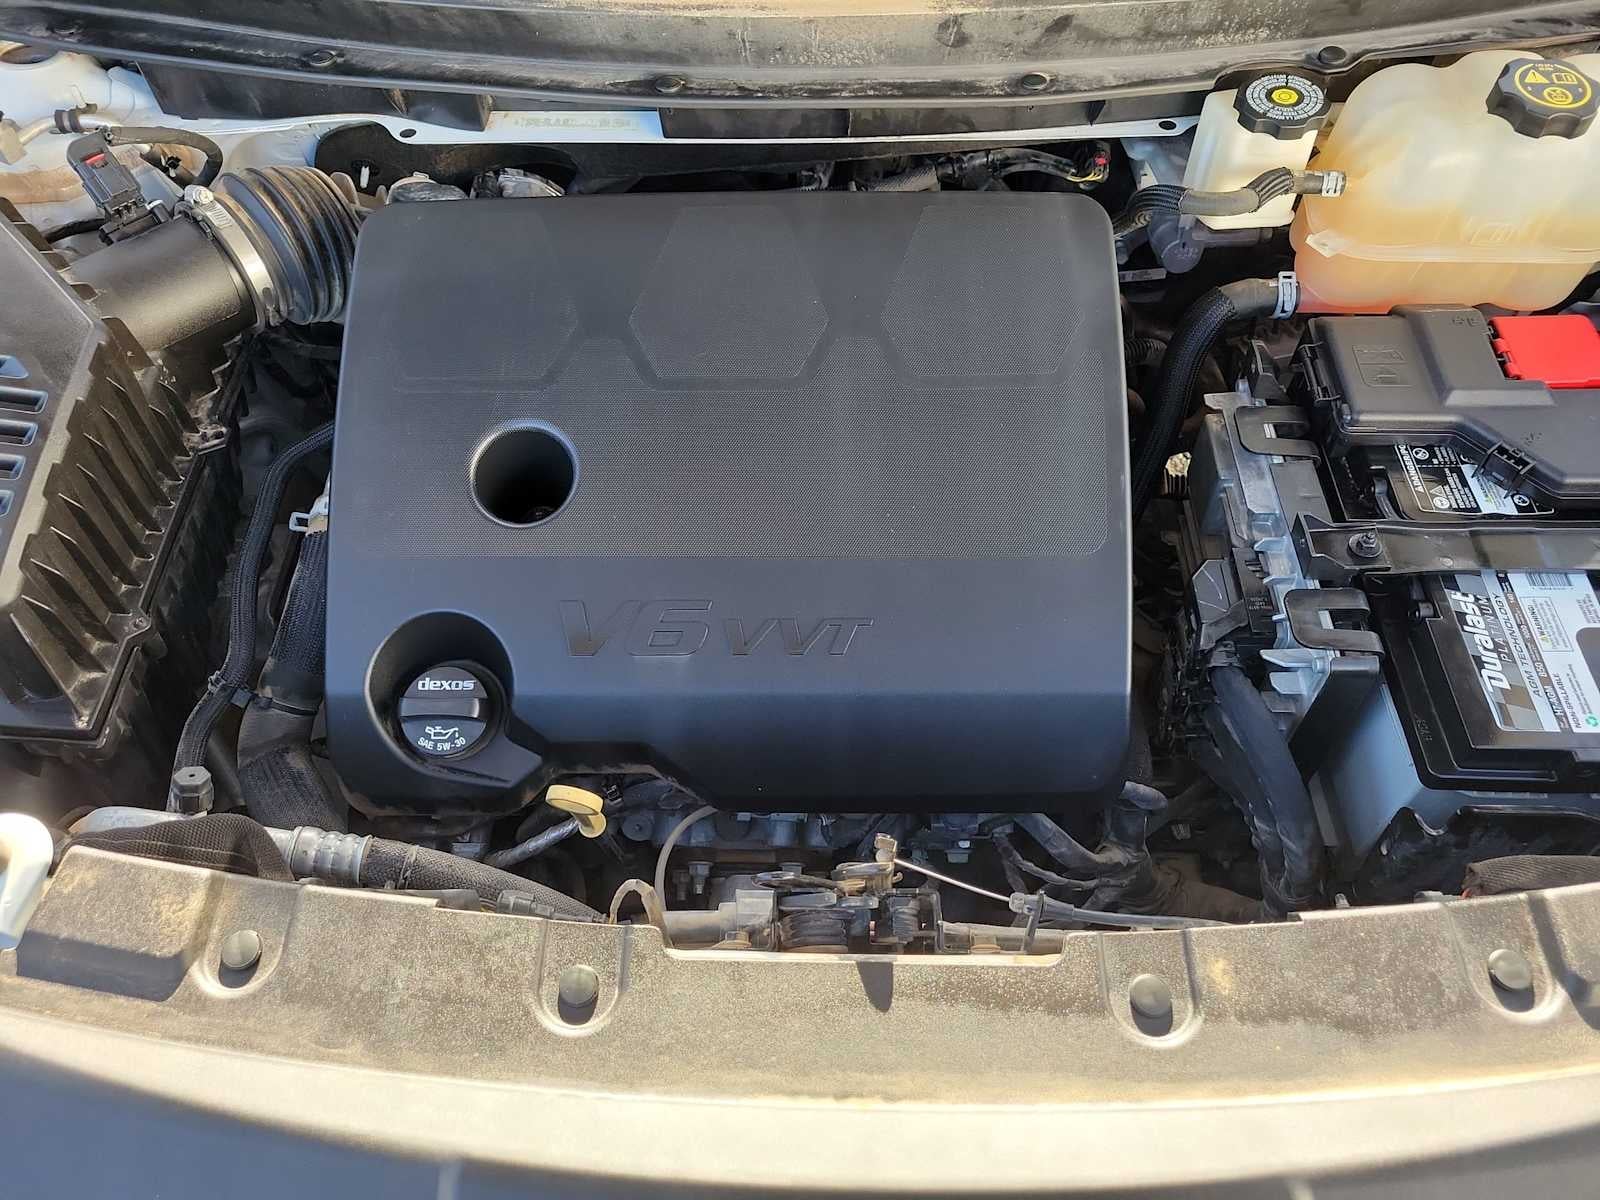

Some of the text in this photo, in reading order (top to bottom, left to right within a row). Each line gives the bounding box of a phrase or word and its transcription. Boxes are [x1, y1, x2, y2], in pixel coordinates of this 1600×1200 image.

[559, 600, 875, 657] V6 VVT
[1450, 591, 1511, 692] Duralast
[1477, 595, 1513, 663] PLATINUM
[1491, 592, 1529, 666] TECHNOLOGY
[417, 678, 477, 691] dexos
[1524, 670, 1542, 698] AGM
[1534, 662, 1547, 677] 850
[417, 737, 466, 751] SAE 5W-30
